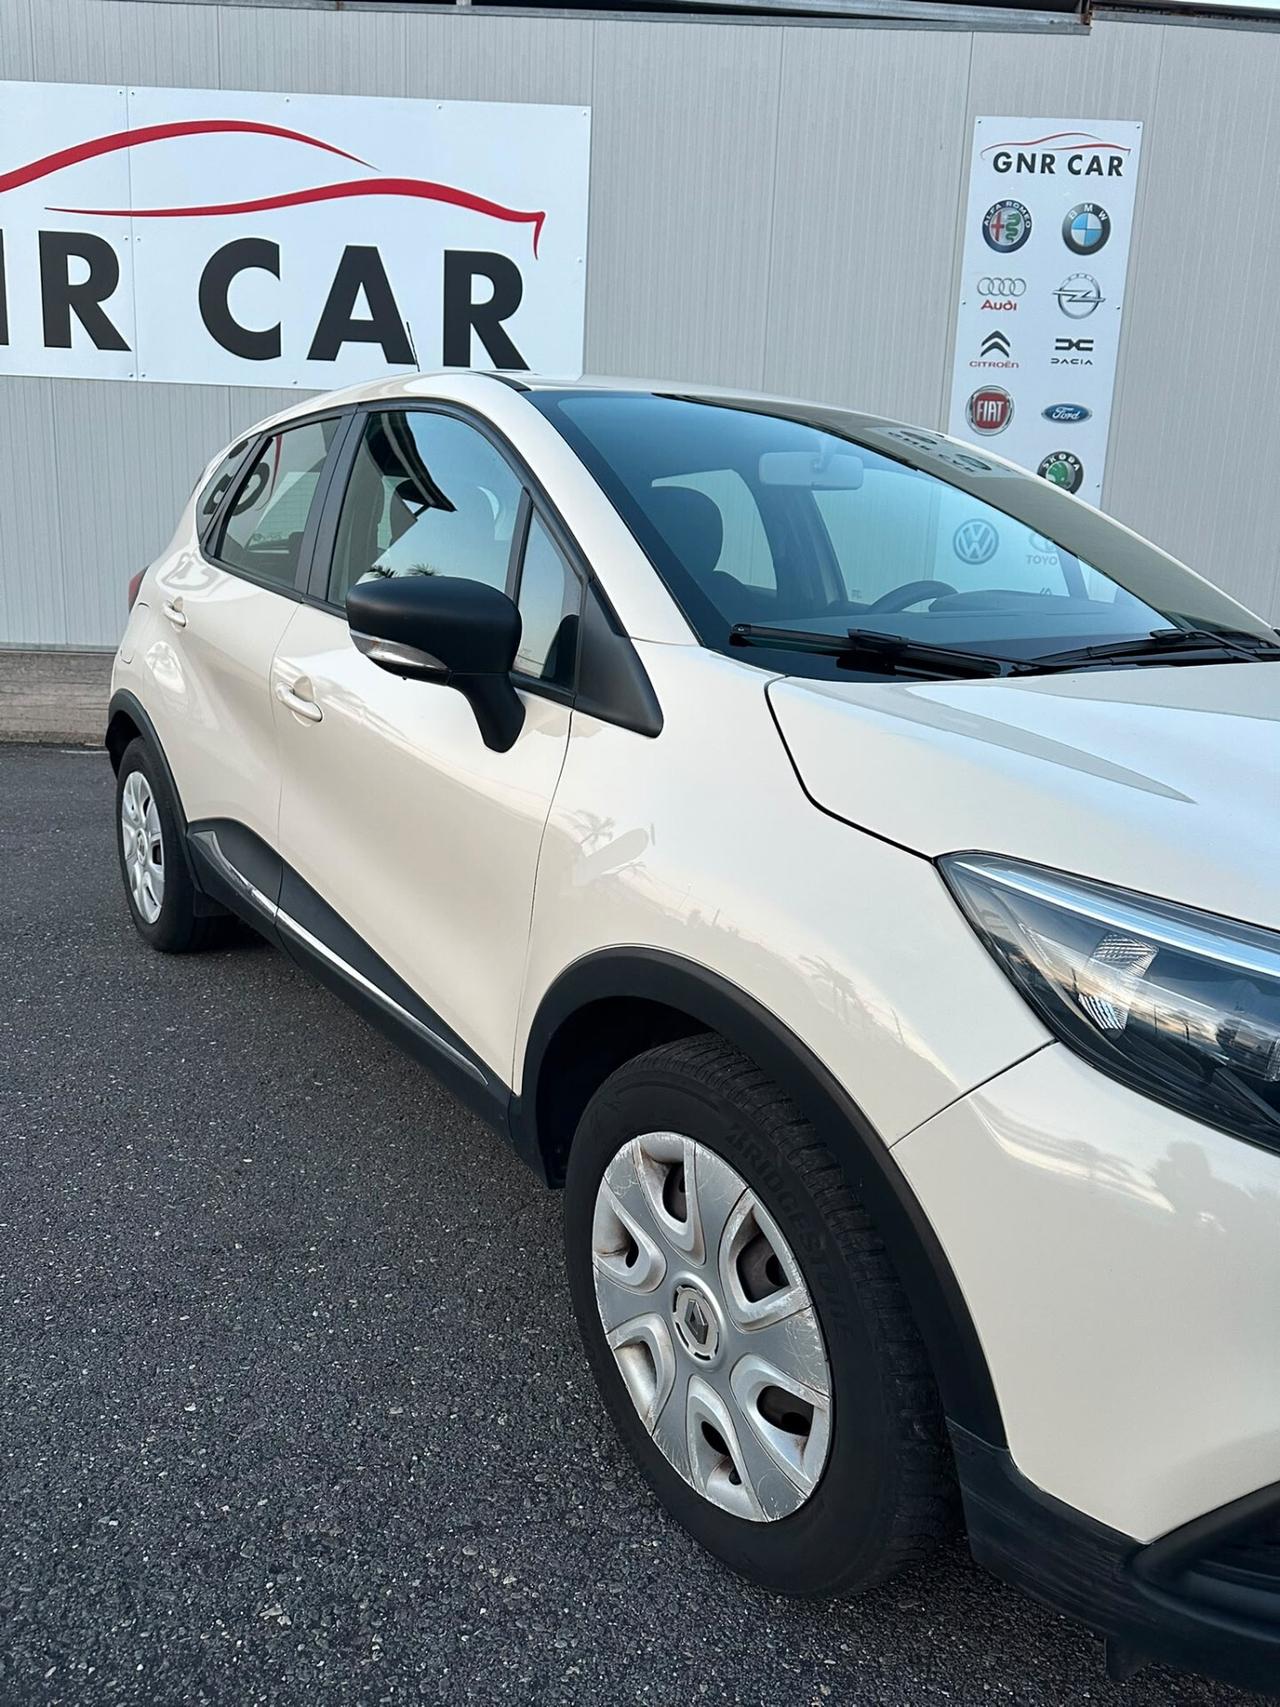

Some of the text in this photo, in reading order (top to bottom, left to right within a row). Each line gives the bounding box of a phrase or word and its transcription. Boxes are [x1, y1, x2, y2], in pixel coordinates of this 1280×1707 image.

[992, 151, 1123, 177] GNR CAR
[984, 200, 1032, 228] ALFA ROMEO
[1069, 204, 1108, 221] BMW
[0, 227, 532, 371] R CAR
[981, 299, 1017, 311] Audi
[976, 400, 1005, 422] FIAT
[1052, 406, 1081, 420] Ford
[1025, 554, 1058, 566] TOYO
